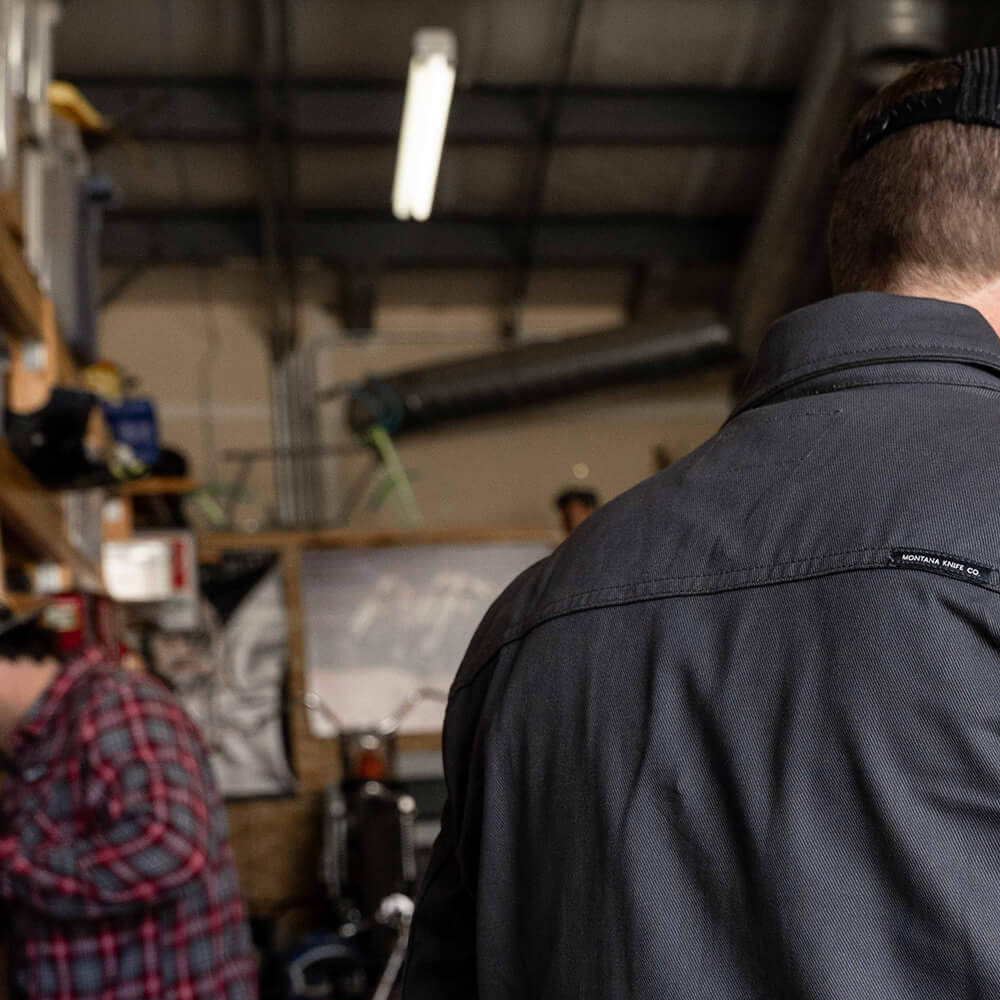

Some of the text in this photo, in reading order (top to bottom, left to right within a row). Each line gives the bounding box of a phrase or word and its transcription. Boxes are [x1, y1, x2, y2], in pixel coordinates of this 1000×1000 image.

[901, 554, 981, 577] MONTANA KNIFE CO.
